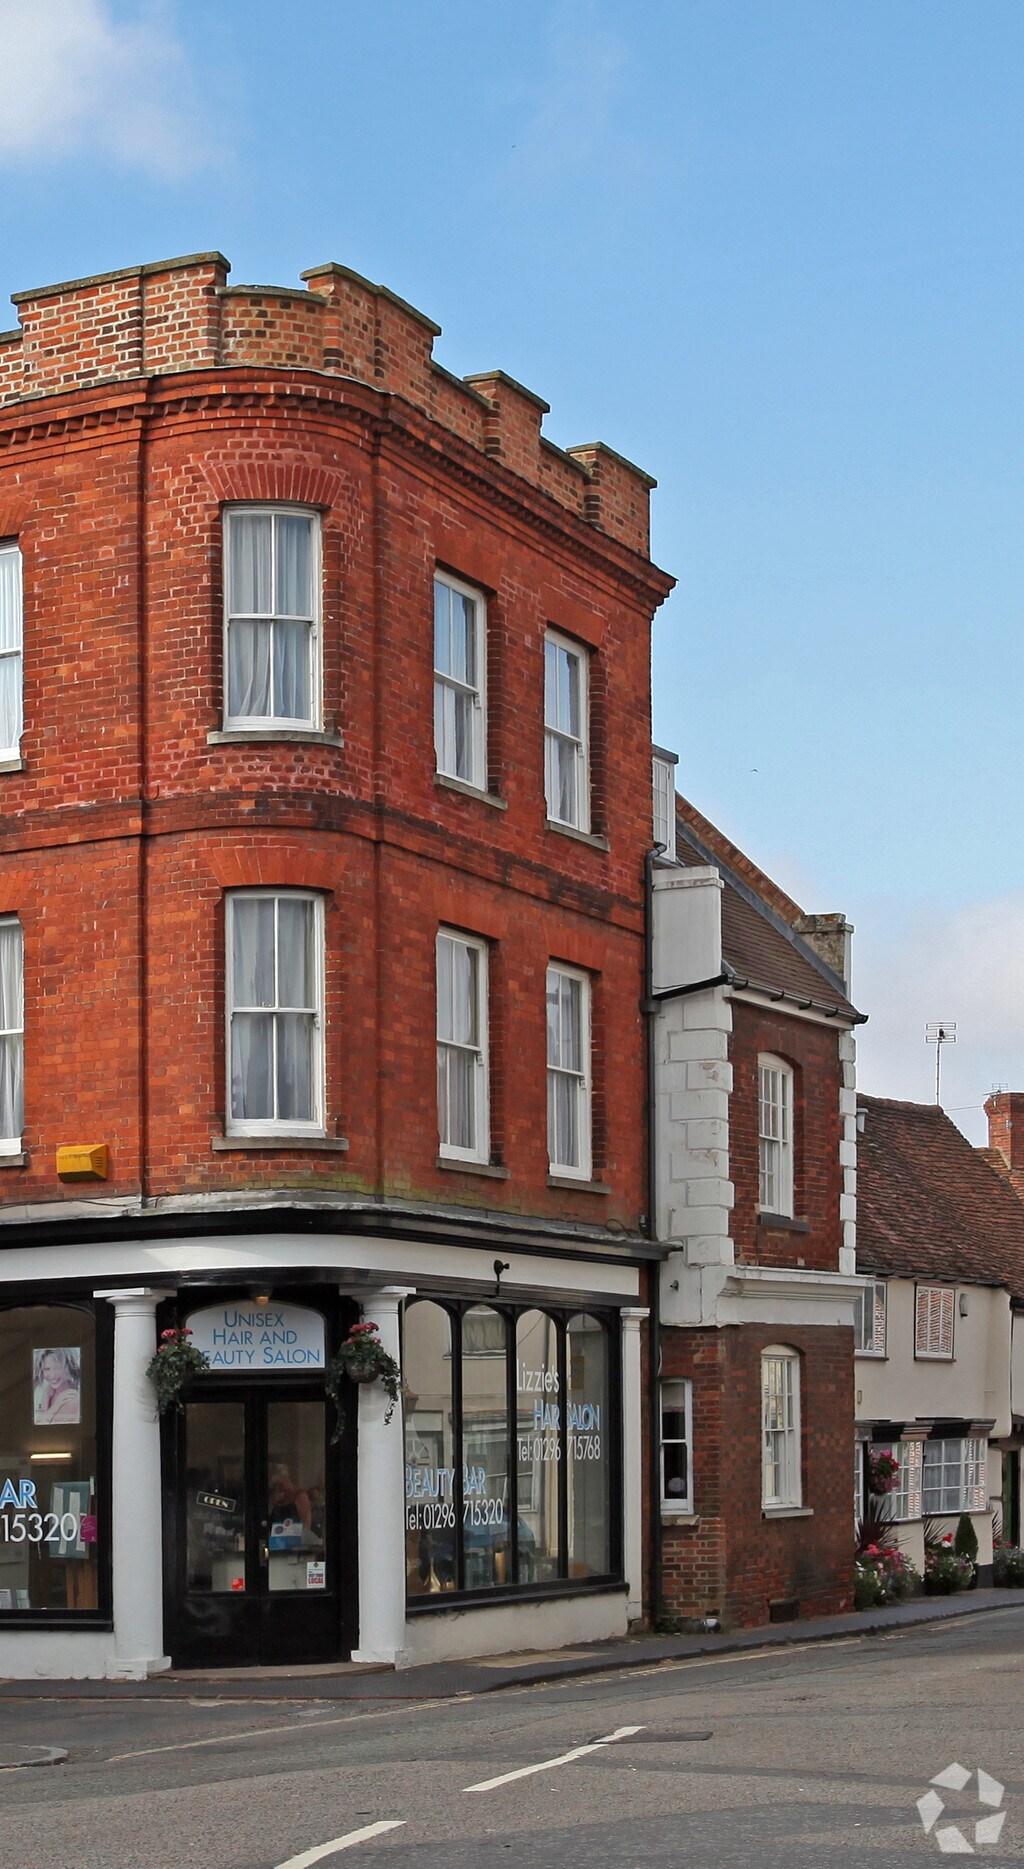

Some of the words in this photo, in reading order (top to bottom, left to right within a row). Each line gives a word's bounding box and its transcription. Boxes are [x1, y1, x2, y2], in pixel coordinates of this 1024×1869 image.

[224, 1311, 284, 1328] UNISEX
[213, 1328, 253, 1345] HAIR
[259, 1330, 298, 1345] AND
[202, 1350, 255, 1364] EAUTY
[263, 1347, 320, 1364] SALON
[516, 1358, 560, 1393] Lizzie's
[533, 1398, 561, 1431] HAIR
[566, 1435, 601, 1460] 715768
[405, 1463, 456, 1498] BEAUTY
[462, 1498, 504, 1526] 715320
